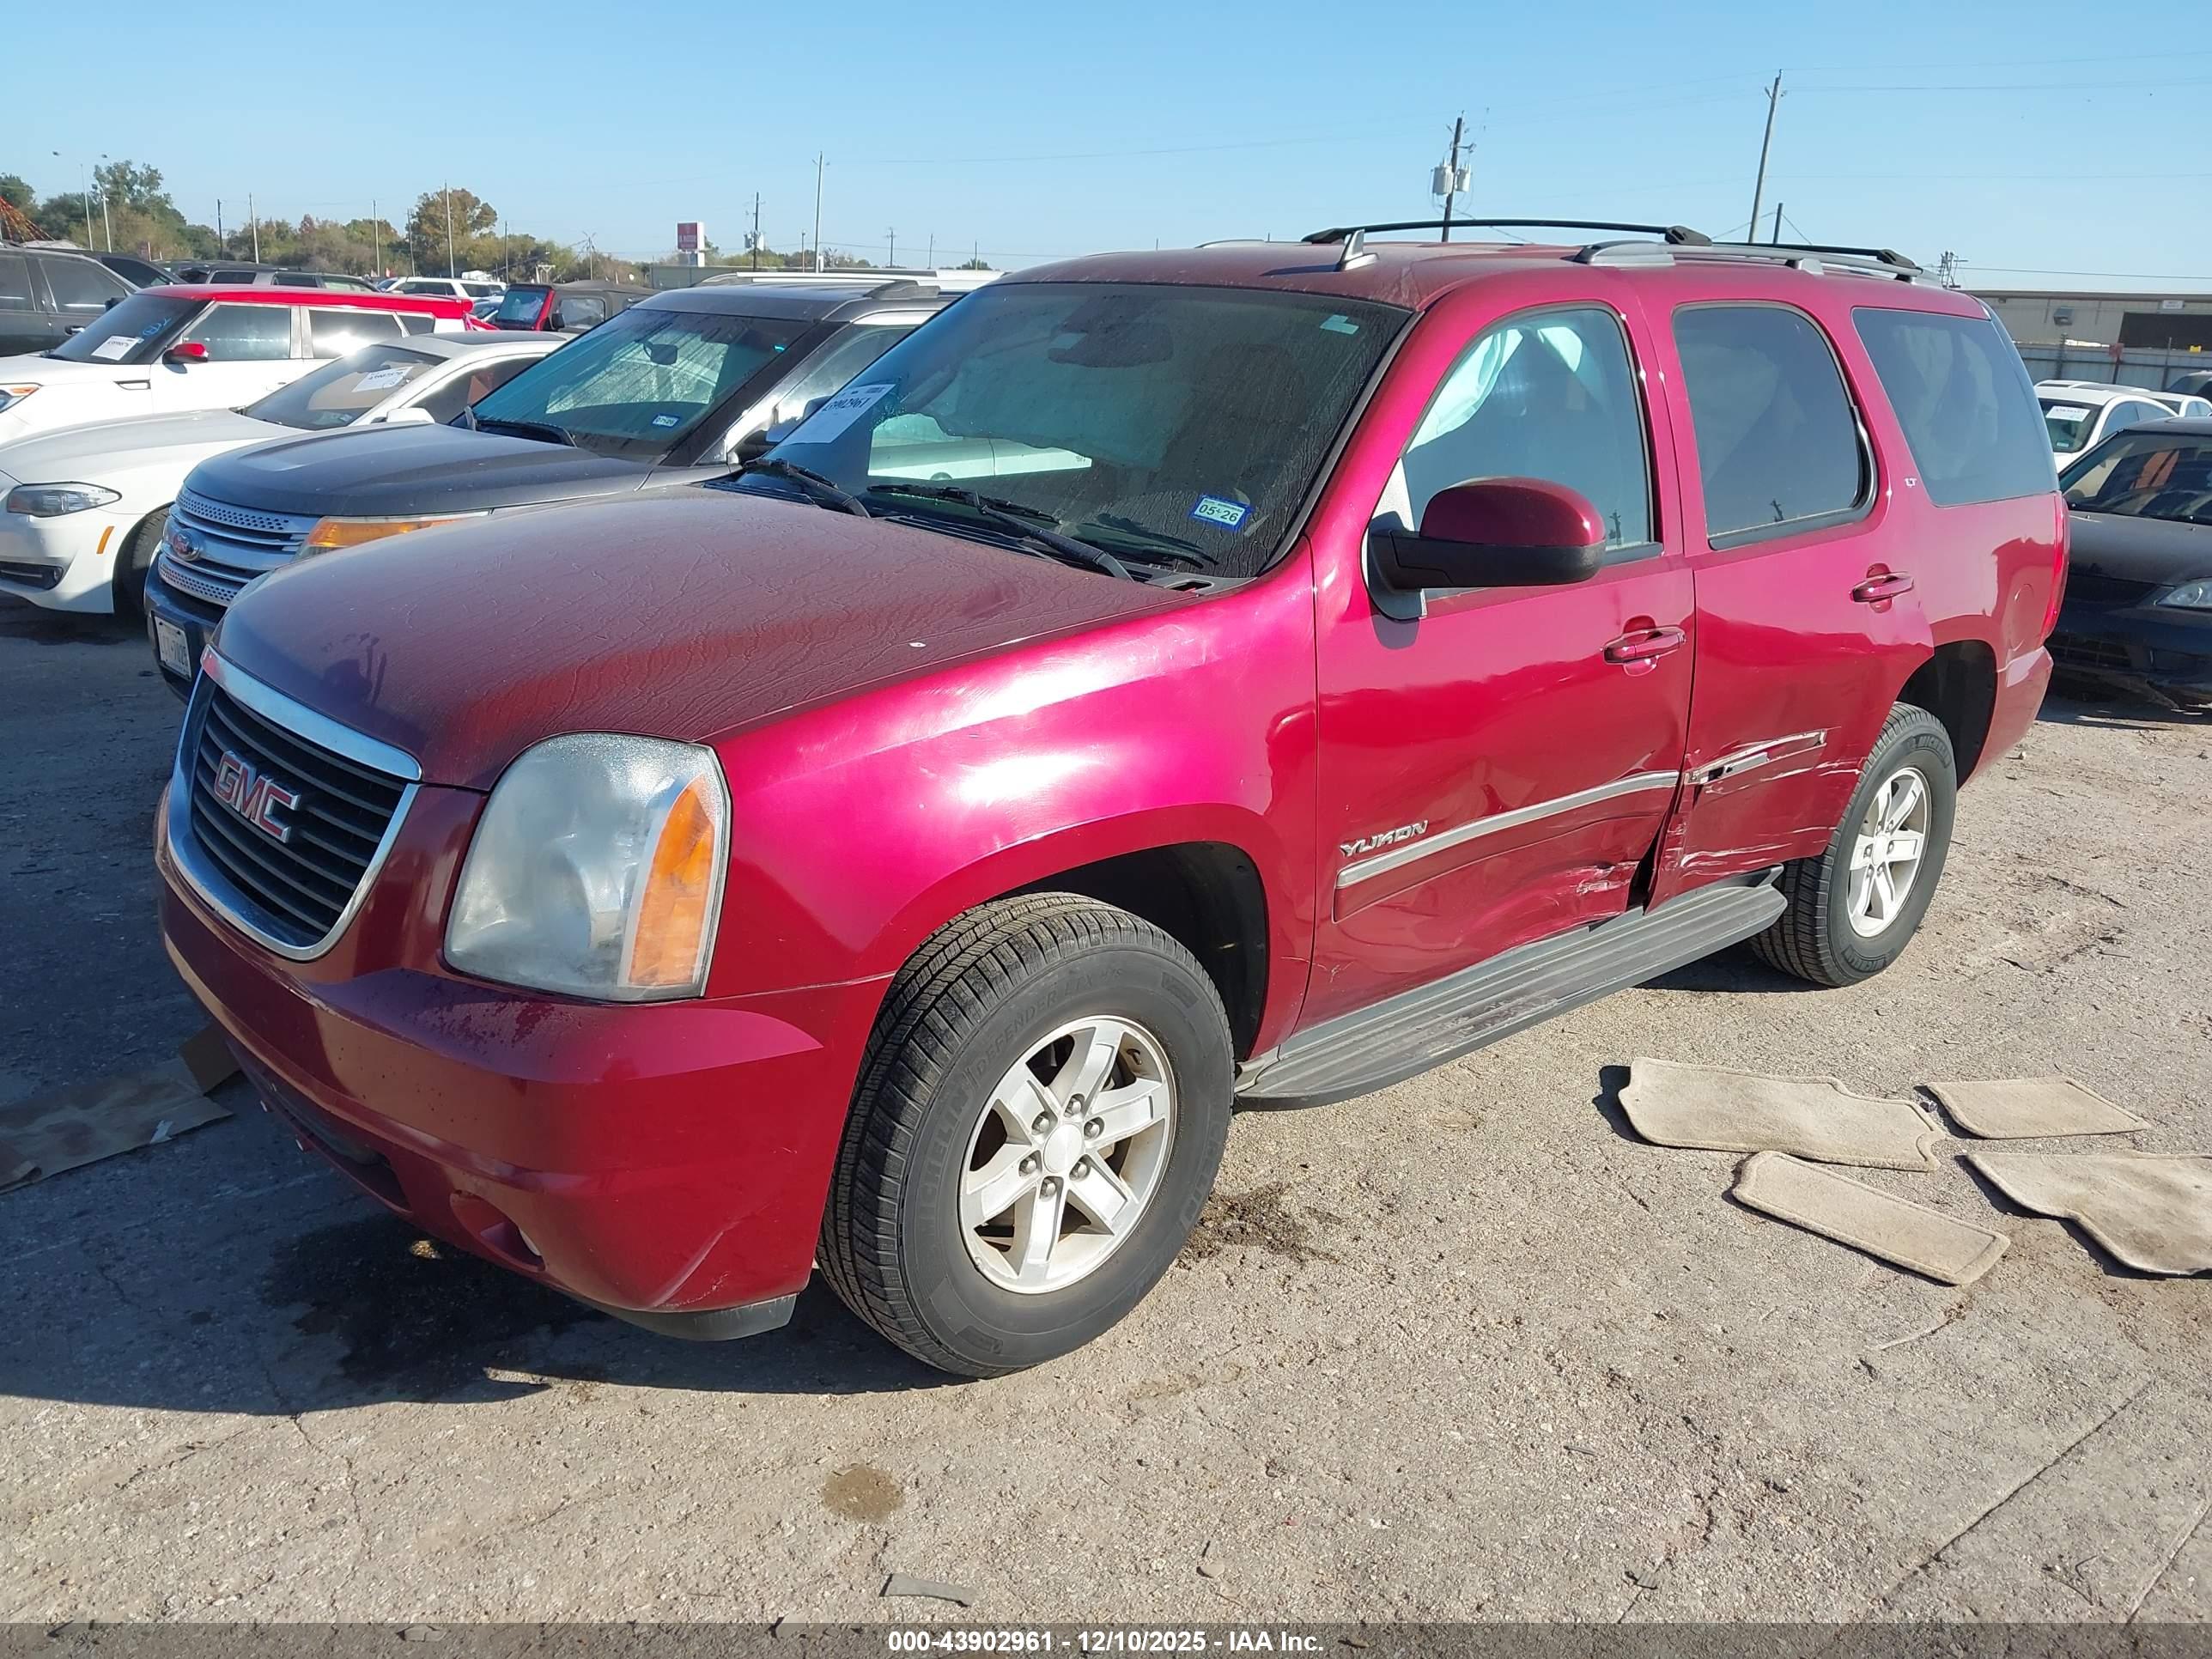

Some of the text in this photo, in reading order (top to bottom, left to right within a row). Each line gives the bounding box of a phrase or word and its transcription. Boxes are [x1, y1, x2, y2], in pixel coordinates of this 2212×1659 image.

[1905, 477, 1917, 489] LT
[214, 750, 301, 843] GMC
[1340, 819, 1429, 857] YUKON
[975, 991, 1061, 1079] DEFENDER
